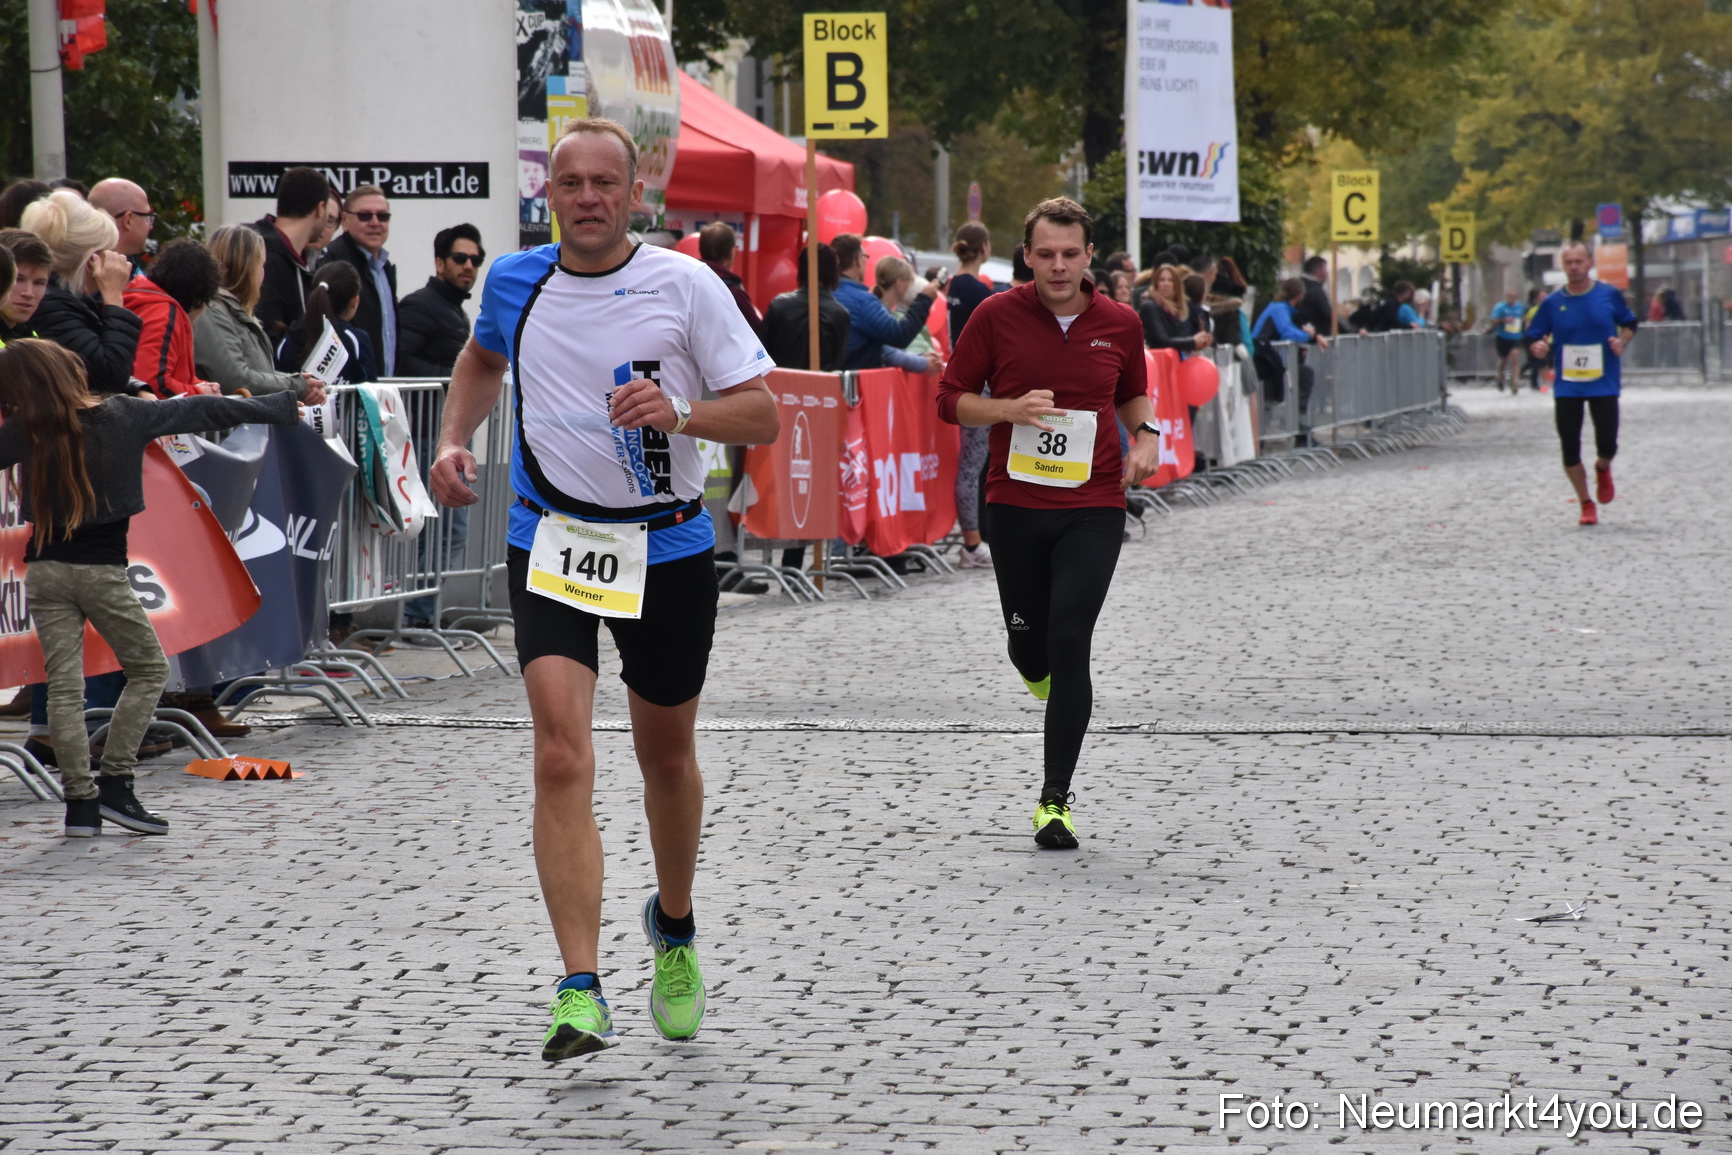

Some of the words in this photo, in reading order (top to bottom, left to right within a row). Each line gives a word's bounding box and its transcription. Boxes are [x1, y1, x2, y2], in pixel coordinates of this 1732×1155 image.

[528, 15, 545, 29] CUP
[814, 19, 876, 41] Block
[826, 52, 867, 111] B
[230, 167, 480, 194] wwwNI-Partl.de
[1337, 174, 1373, 188] Block
[1343, 192, 1366, 225] C
[1449, 227, 1466, 250] D
[317, 344, 338, 374] swn
[1574, 356, 1588, 367] 47
[632, 361, 676, 496] HBER
[1037, 431, 1067, 456] 38
[1034, 461, 1064, 473] Sandro
[560, 547, 618, 584] 140
[564, 582, 604, 602] Werner
